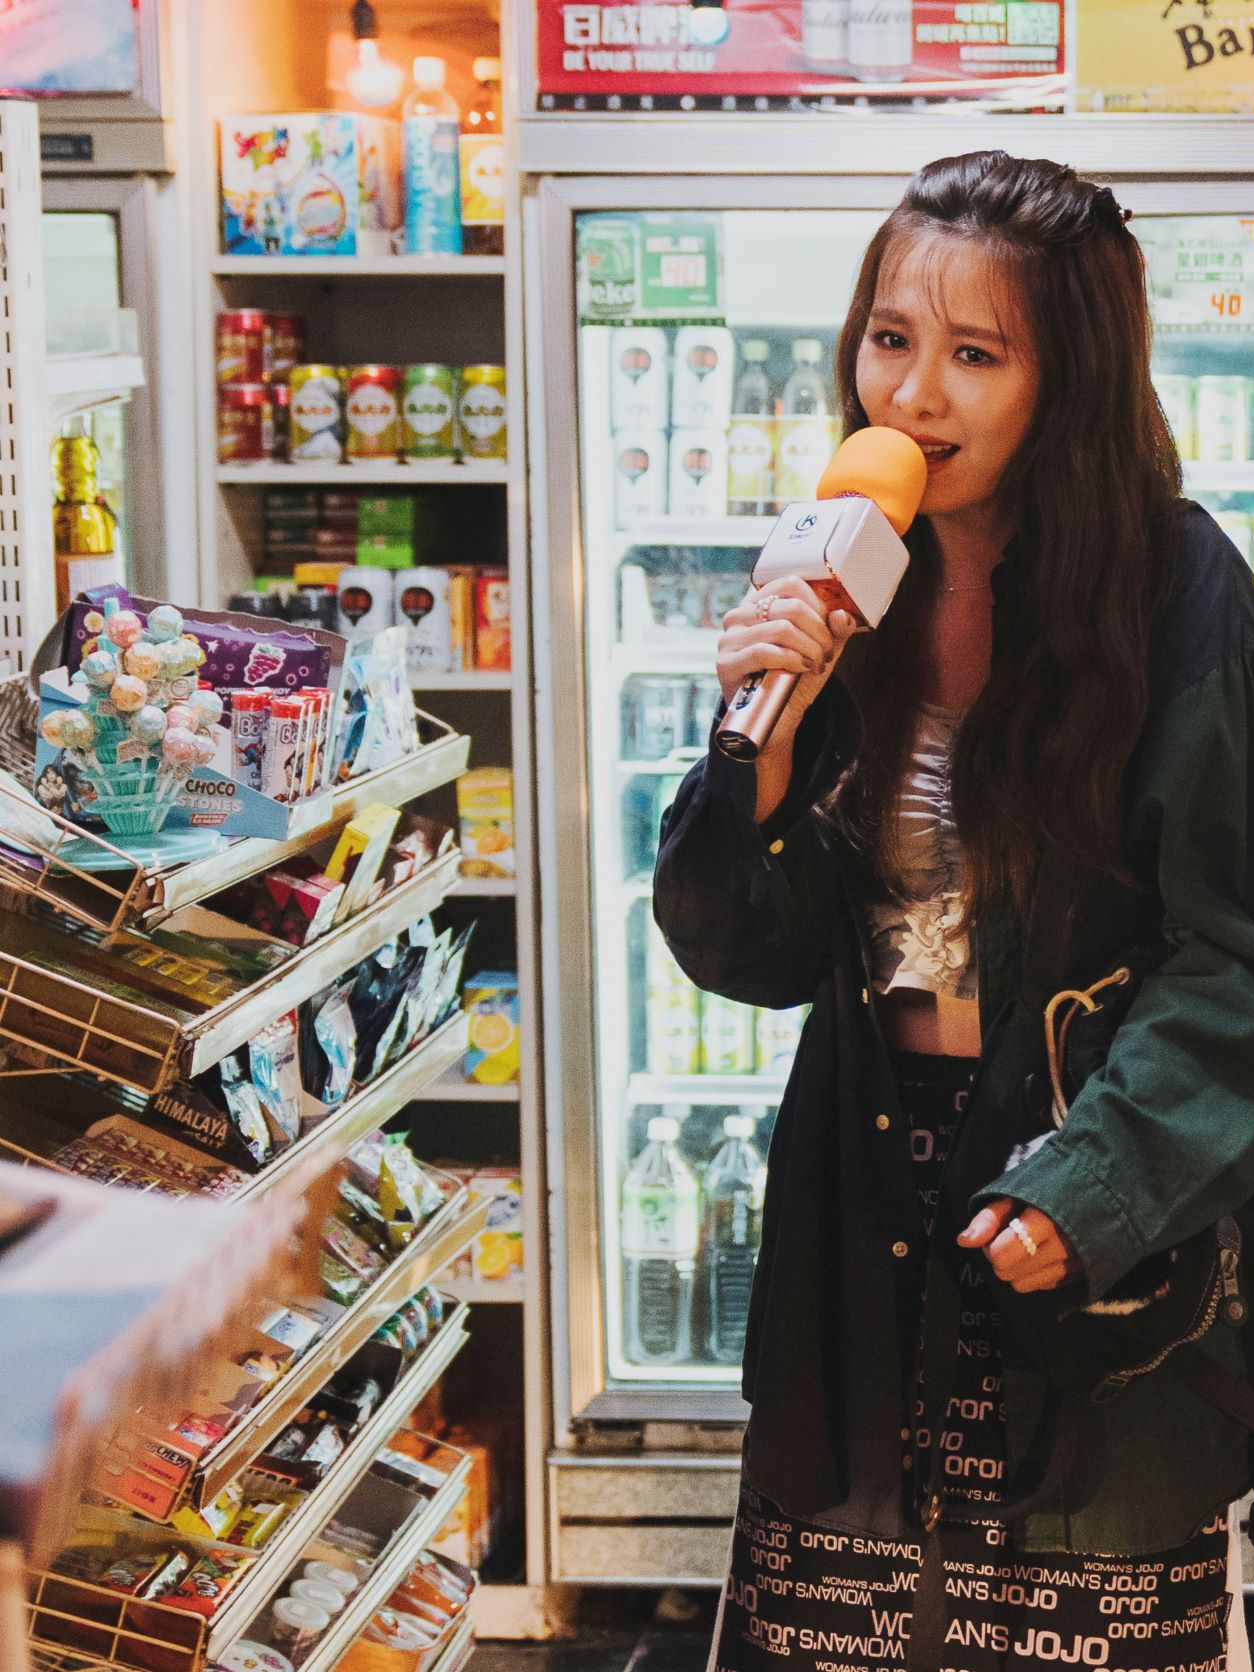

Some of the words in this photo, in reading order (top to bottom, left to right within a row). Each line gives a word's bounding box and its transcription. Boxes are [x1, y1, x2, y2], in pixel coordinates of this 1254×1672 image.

[1210, 292, 1241, 317] 40
[185, 779, 236, 797] CHOCO
[154, 1094, 229, 1141] HIMALAYA
[799, 1531, 849, 1552] JOJO
[751, 1546, 792, 1571] JOJO
[1083, 1561, 1134, 1574] WOMAN'S
[1135, 1563, 1164, 1574] JOJO
[976, 1565, 1011, 1578] JOJO
[1013, 1564, 1102, 1590] WOMAN'S
[1104, 1575, 1158, 1592] JOJO
[1169, 1560, 1208, 1583] JOJO
[756, 1573, 793, 1596] JOJO
[795, 1582, 873, 1607] WOMAN'S
[821, 1576, 868, 1591] WOMAN'S
[868, 1582, 898, 1593] JOJO
[992, 1583, 1058, 1611] JOJO
[1098, 1596, 1160, 1615] JOJO
[750, 1615, 796, 1646] JOJO
[1107, 1622, 1160, 1639] JOJO
[1160, 1611, 1219, 1637] WOMAN'S
[766, 1642, 791, 1656] JOJO
[799, 1628, 905, 1660] WOMAN'S
[1014, 1628, 1110, 1666] JOJO
